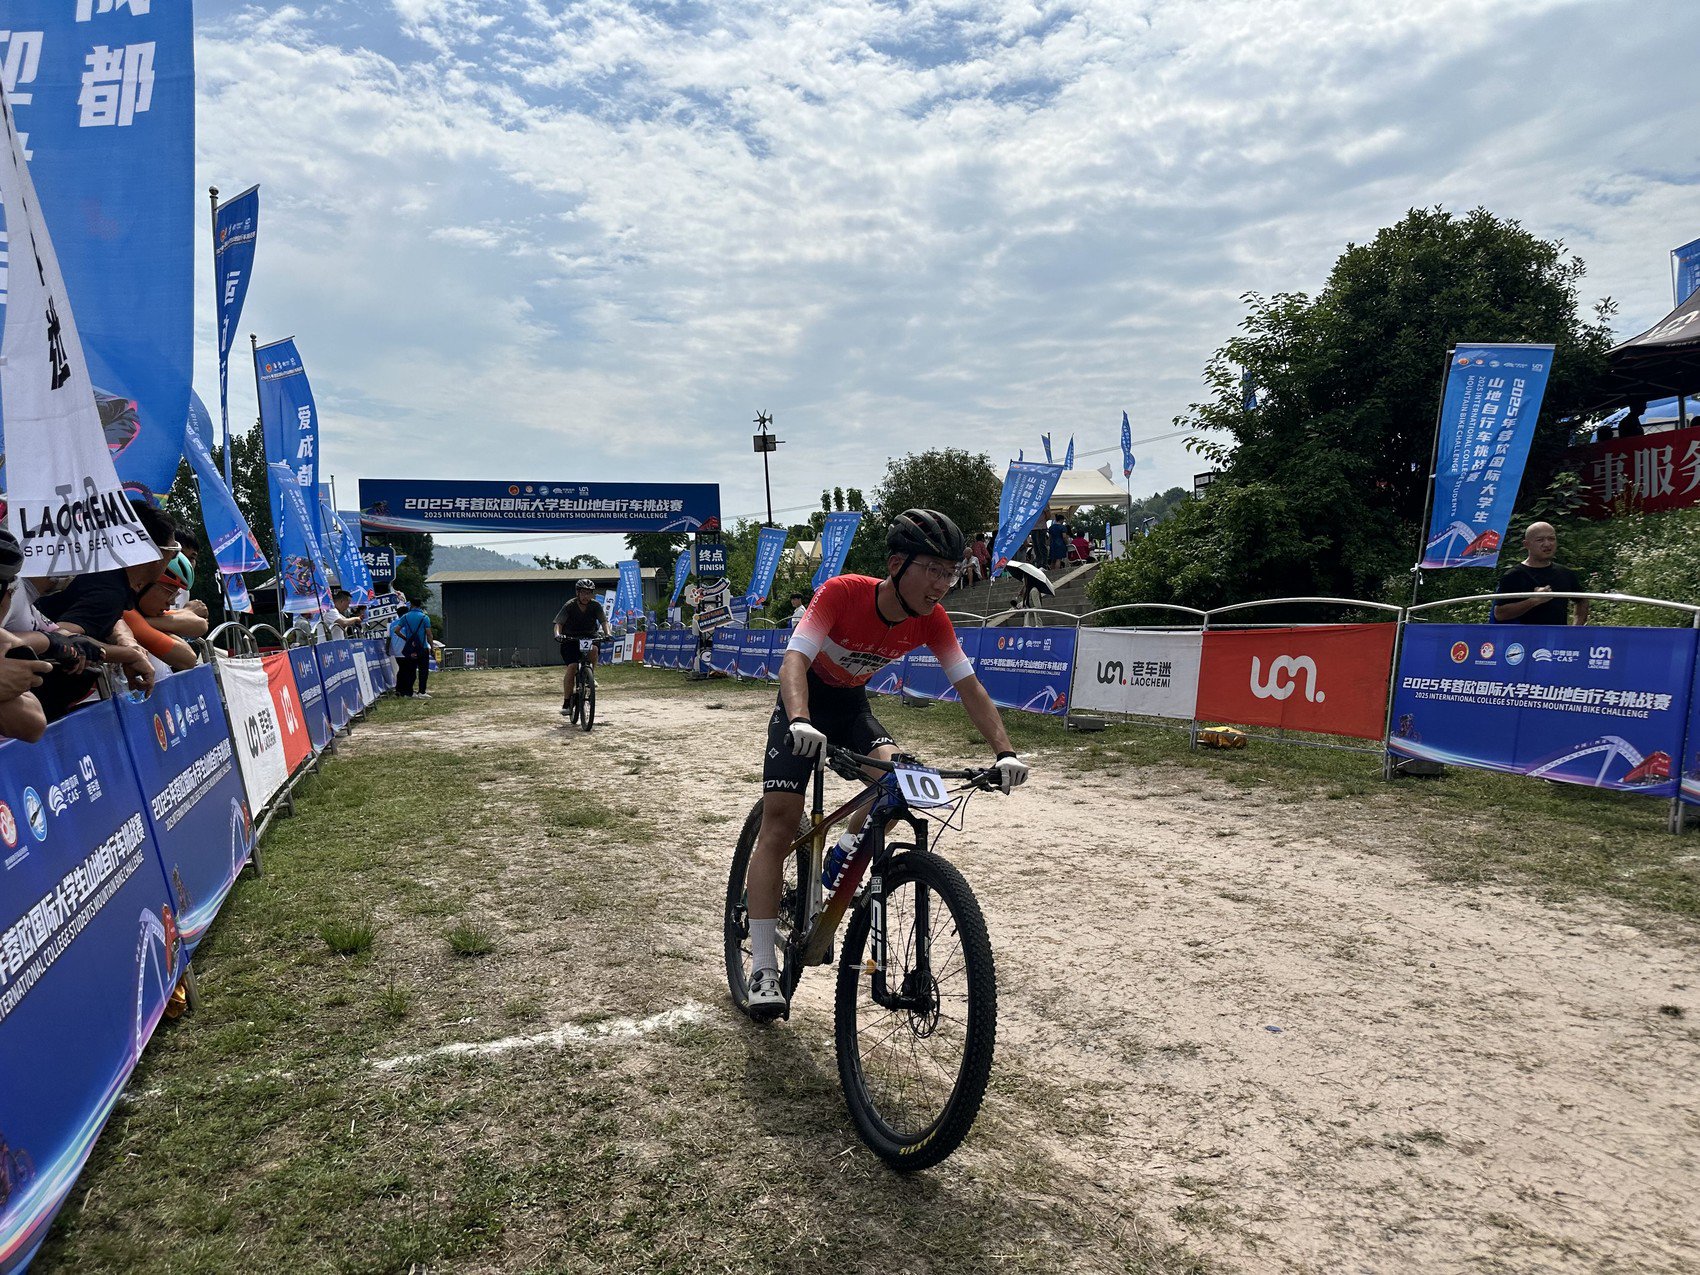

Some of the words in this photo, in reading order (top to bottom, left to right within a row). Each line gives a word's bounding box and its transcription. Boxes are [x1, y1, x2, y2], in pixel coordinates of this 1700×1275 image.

[75, 0, 156, 127] 都
[297, 404, 315, 487] 爱成都
[19, 490, 138, 539] LAOCHEMI
[404, 497, 684, 512] 2025年蓉欧国际大学生山地自行车挑战赛
[24, 542, 81, 557] SPORTS
[88, 529, 150, 551] SERVICE
[362, 552, 391, 567] 终点
[699, 549, 724, 562] 终点
[369, 568, 392, 577] NISH
[583, 641, 589, 649] 2
[1132, 661, 1172, 677] 老车迷
[1130, 677, 1171, 688] LAOCHEMI
[1402, 677, 1673, 711] 2025年蓉欧国际大学生山地自行车挑战赛
[1415, 692, 1429, 700] 2025
[1429, 693, 1476, 703] INTERNATIONAL
[1476, 697, 1505, 706] COLLEGE
[1506, 700, 1542, 709] STUDENTS
[1542, 702, 1582, 713] MOUNTAIN
[1582, 706, 1600, 714] BIKE
[1601, 706, 1649, 719] CHALLENGE
[871, 737, 894, 747] XIN
[905, 774, 940, 801] 10
[44, 928, 70, 966] COLLEGE
[69, 901, 96, 940] STUDENTS
[95, 880, 118, 912] MOUNTAIN
